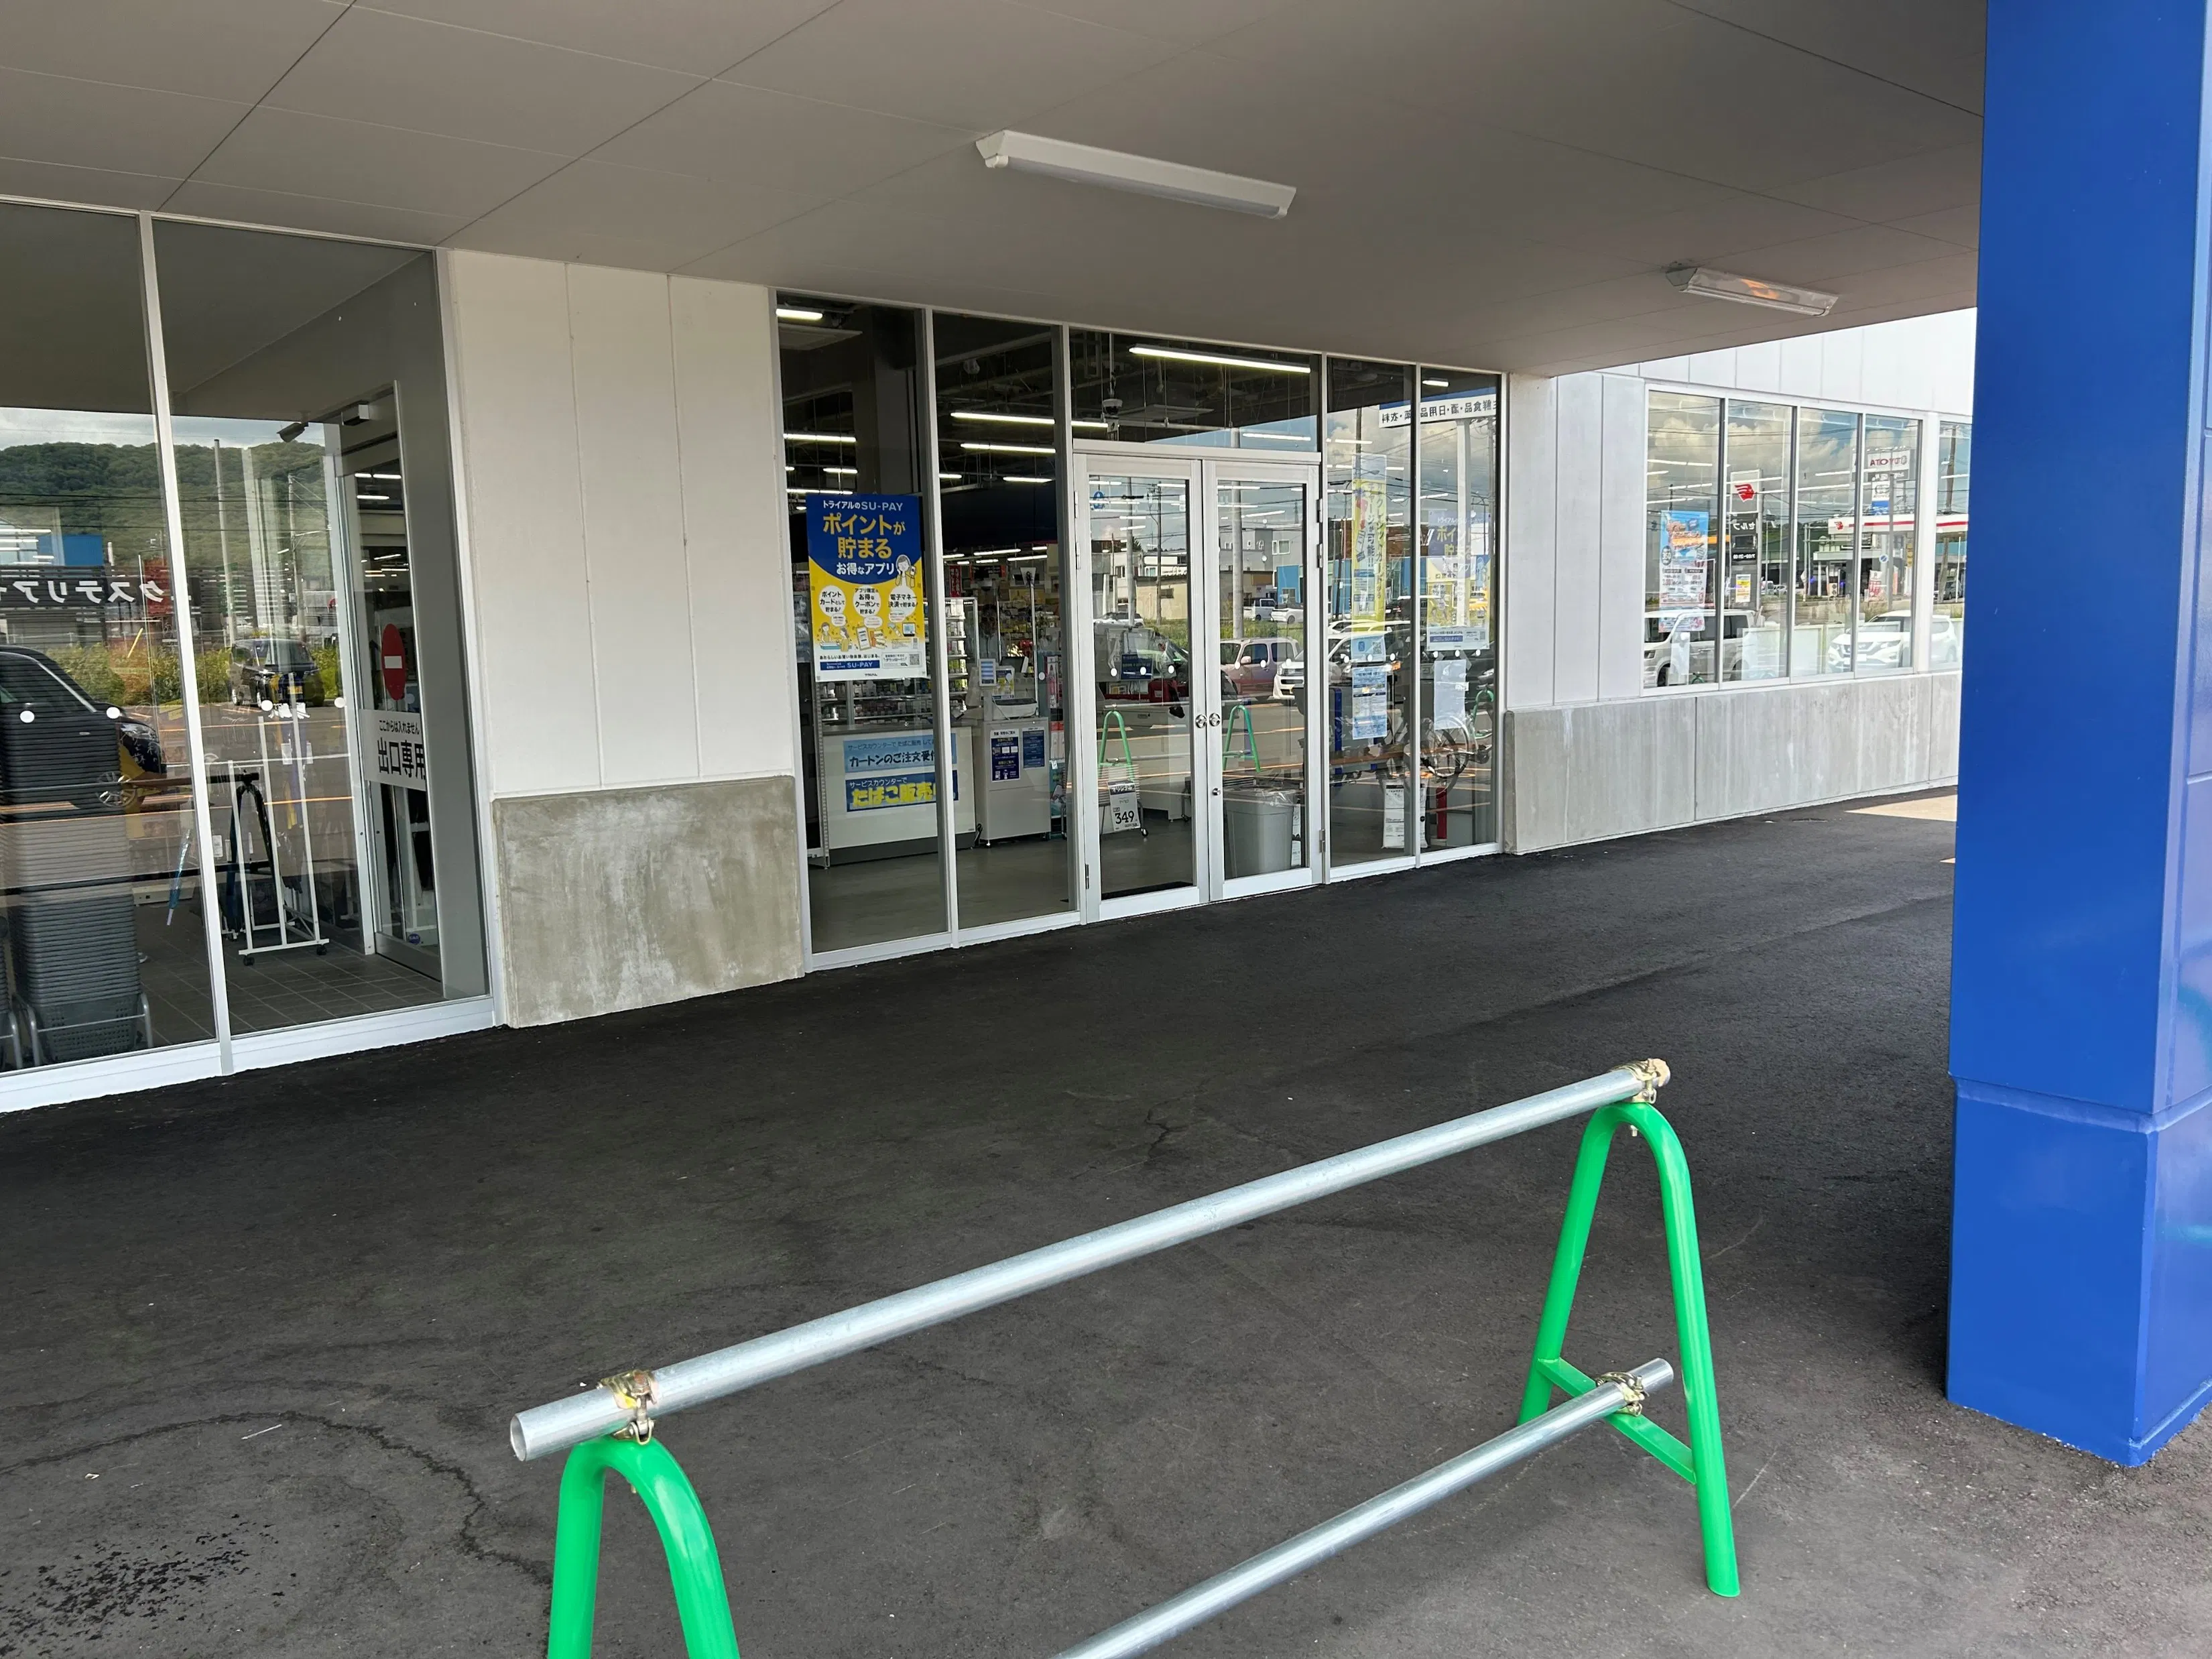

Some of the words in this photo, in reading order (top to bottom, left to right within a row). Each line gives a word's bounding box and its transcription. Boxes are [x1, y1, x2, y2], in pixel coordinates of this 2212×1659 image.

[823, 500, 903, 511] トライアルのSU-PAY
[823, 512, 906, 536] ポイントが
[838, 537, 892, 559] 貯まる
[837, 562, 894, 576] お得なアプリ
[379, 720, 420, 735] ここからは入れません
[848, 742, 896, 751] サービスカウンターで
[377, 737, 426, 780] 出口専用
[849, 777, 907, 789] サービスカウンターで
[852, 782, 936, 808] たばこ販売
[1114, 810, 1135, 824] 349
